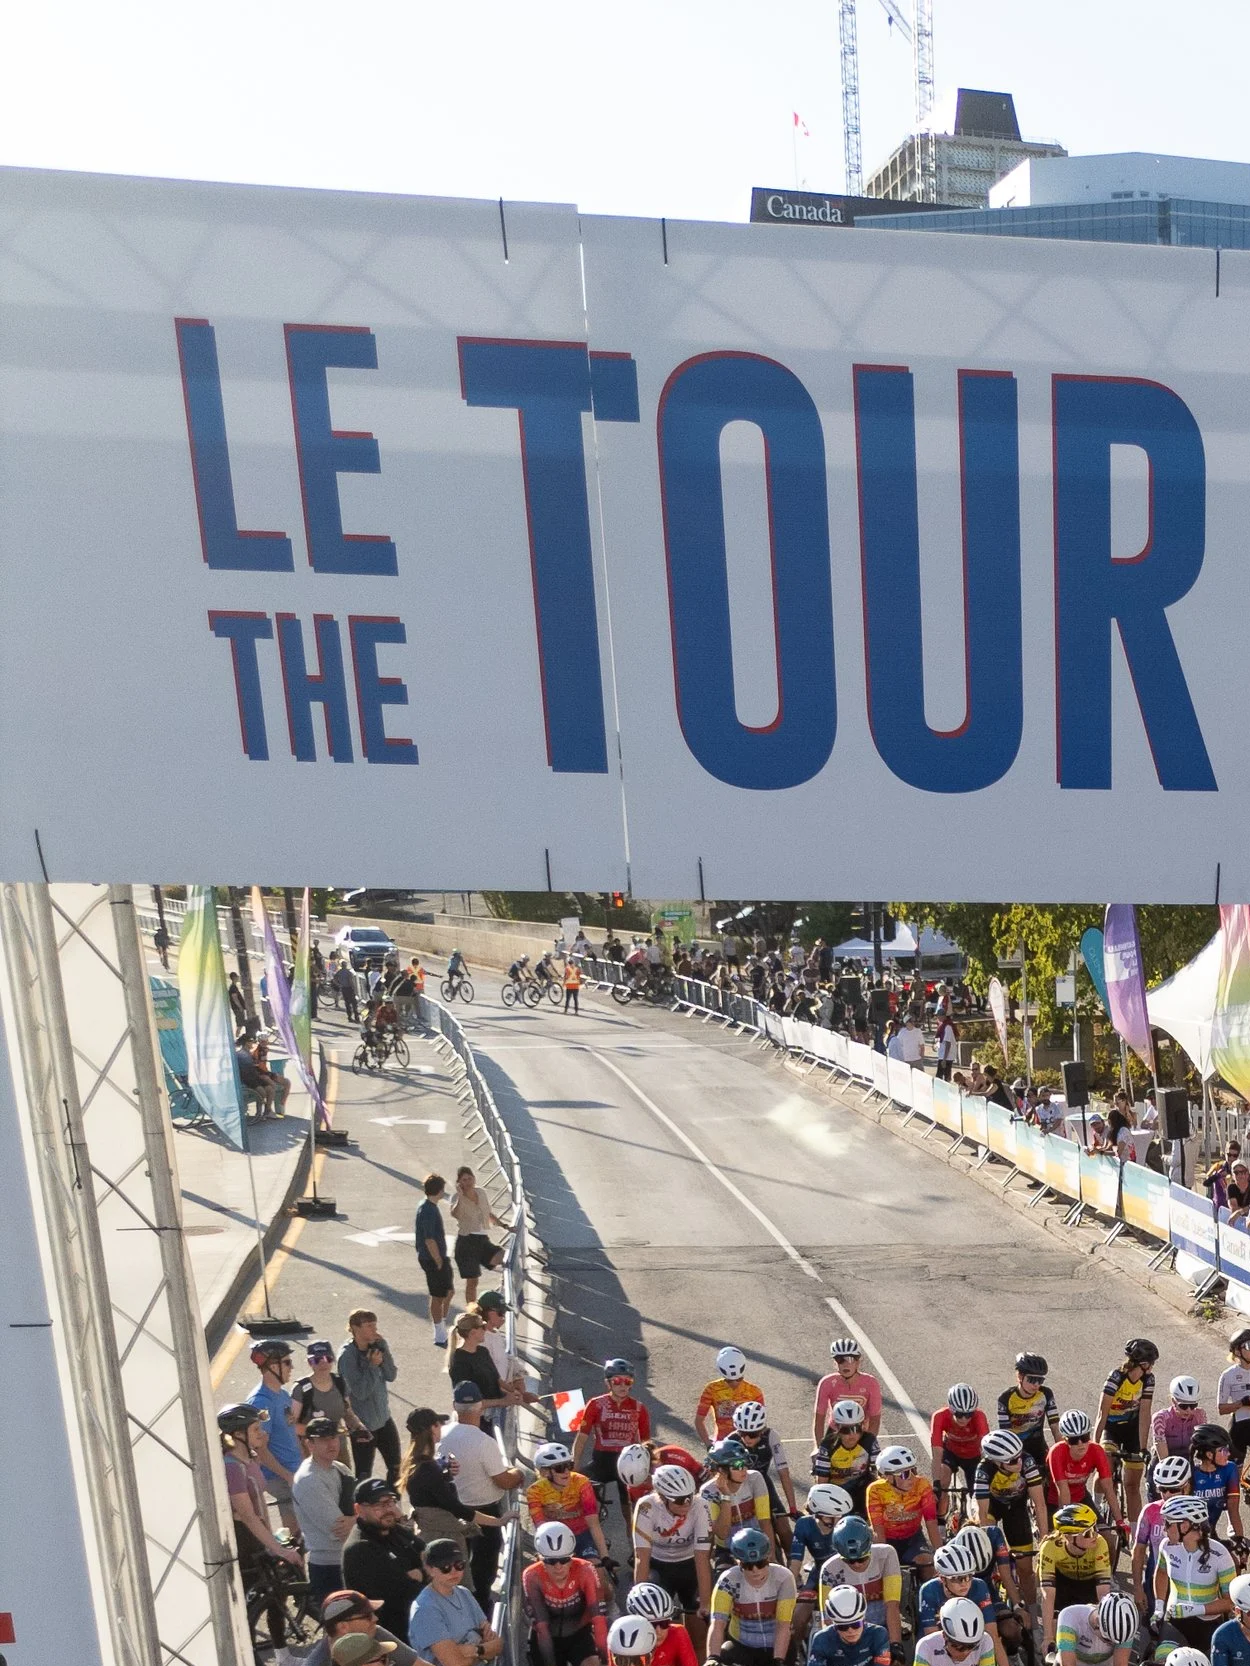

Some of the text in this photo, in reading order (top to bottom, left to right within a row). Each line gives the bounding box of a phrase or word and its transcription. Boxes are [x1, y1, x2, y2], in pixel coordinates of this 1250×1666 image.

[766, 194, 844, 223] Canada
[174, 317, 399, 577] LE
[457, 335, 1219, 793] TOUR
[207, 609, 419, 766] THE
